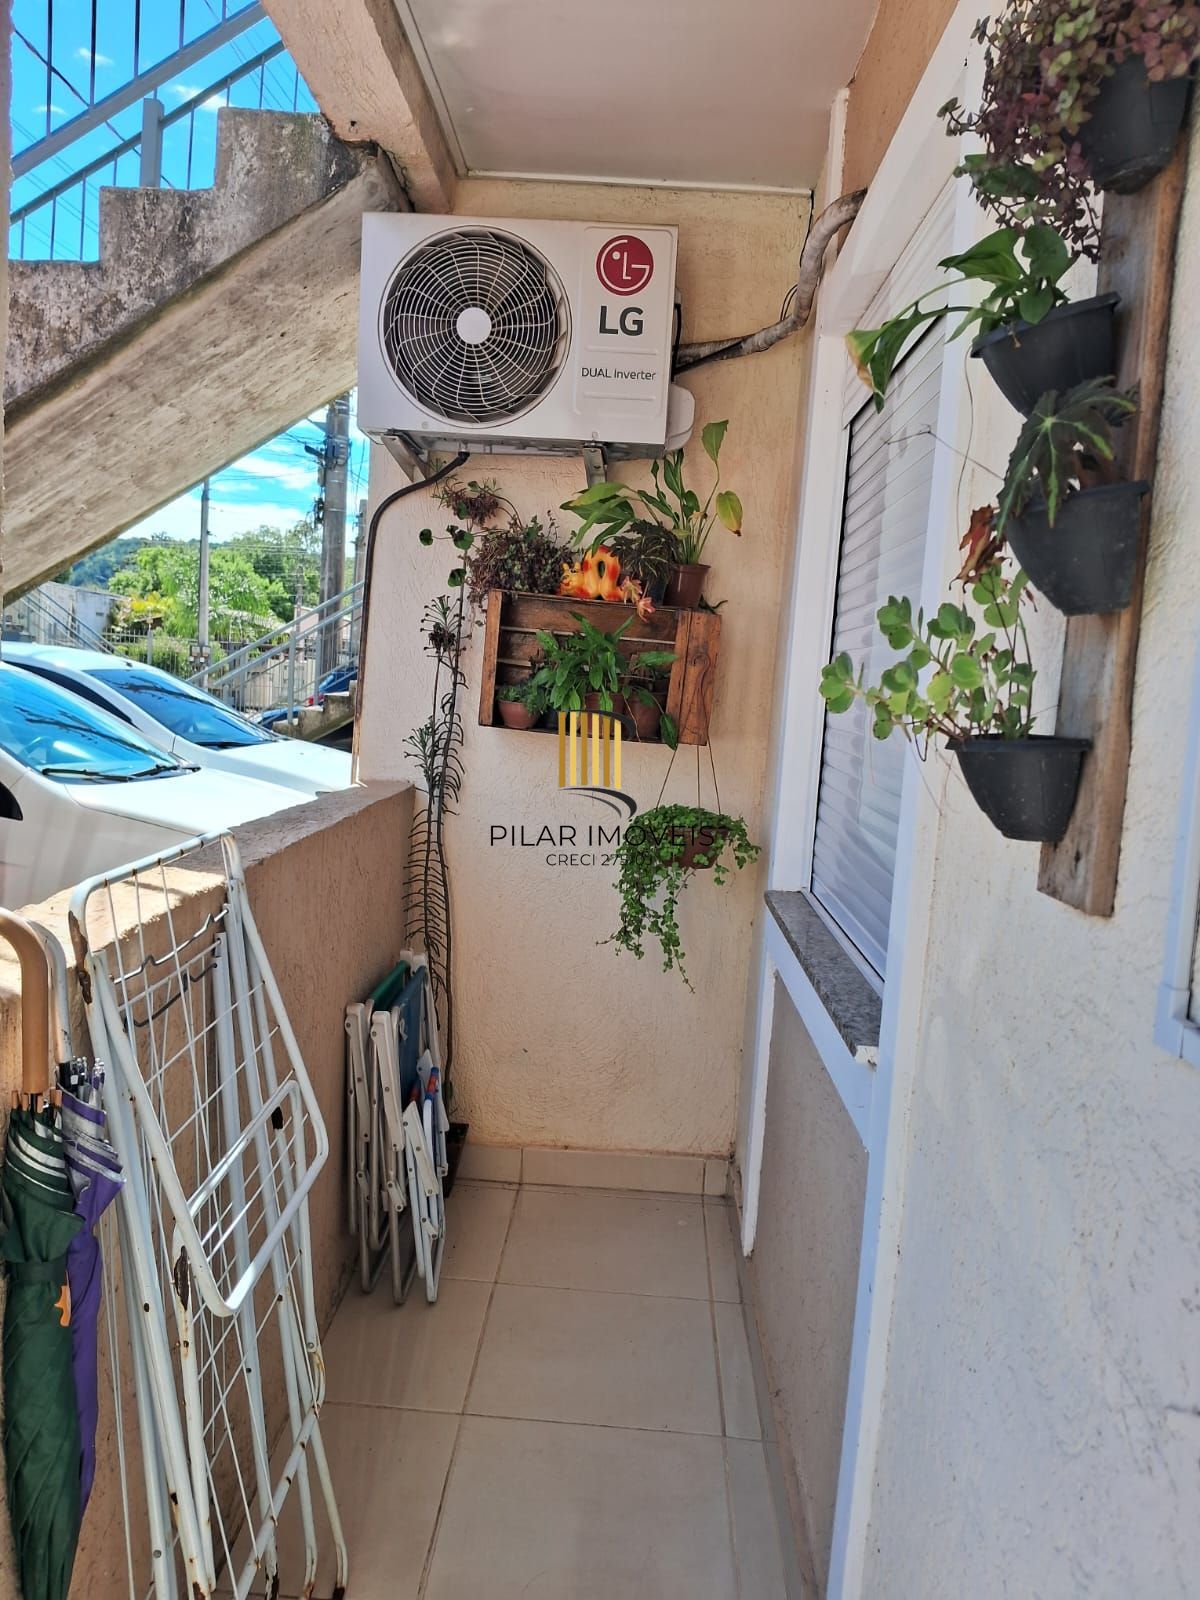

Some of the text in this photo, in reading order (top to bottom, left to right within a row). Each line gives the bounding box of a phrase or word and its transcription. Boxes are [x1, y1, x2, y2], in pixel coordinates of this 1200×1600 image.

[599, 305, 644, 336] LG
[581, 367, 656, 381] DUAL Inverter
